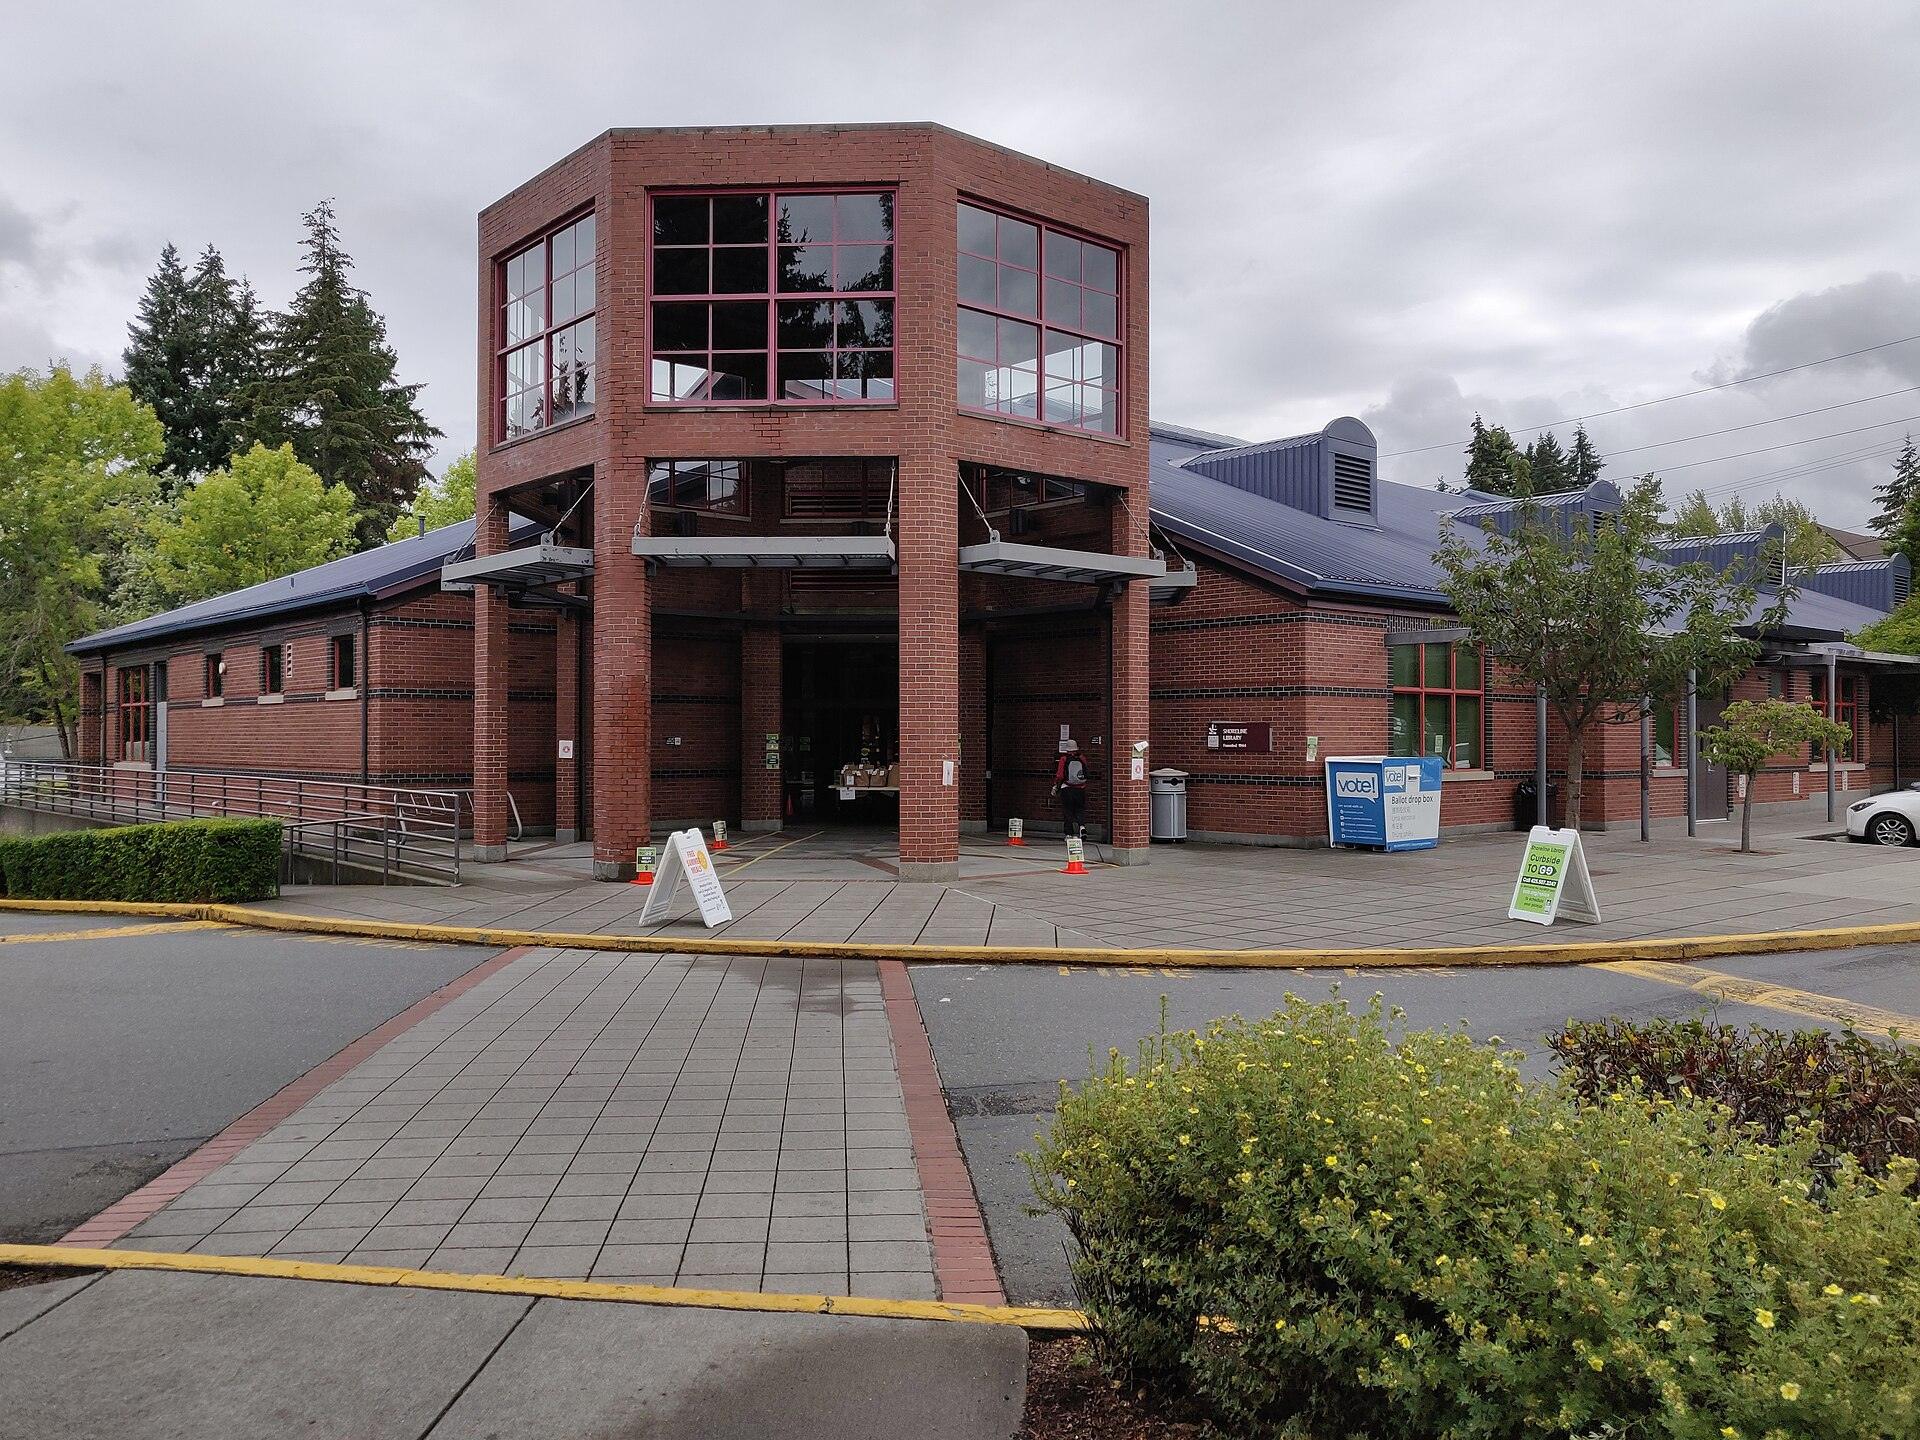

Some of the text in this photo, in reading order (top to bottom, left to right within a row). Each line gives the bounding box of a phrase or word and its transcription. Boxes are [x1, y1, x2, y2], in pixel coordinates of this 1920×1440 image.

[1338, 777, 1376, 794] vote!
[1391, 794, 1434, 806] Ballot drop box
[1550, 846, 1566, 854] Library
[1530, 854, 1561, 864] Curbside
[1527, 864, 1538, 873] TO
